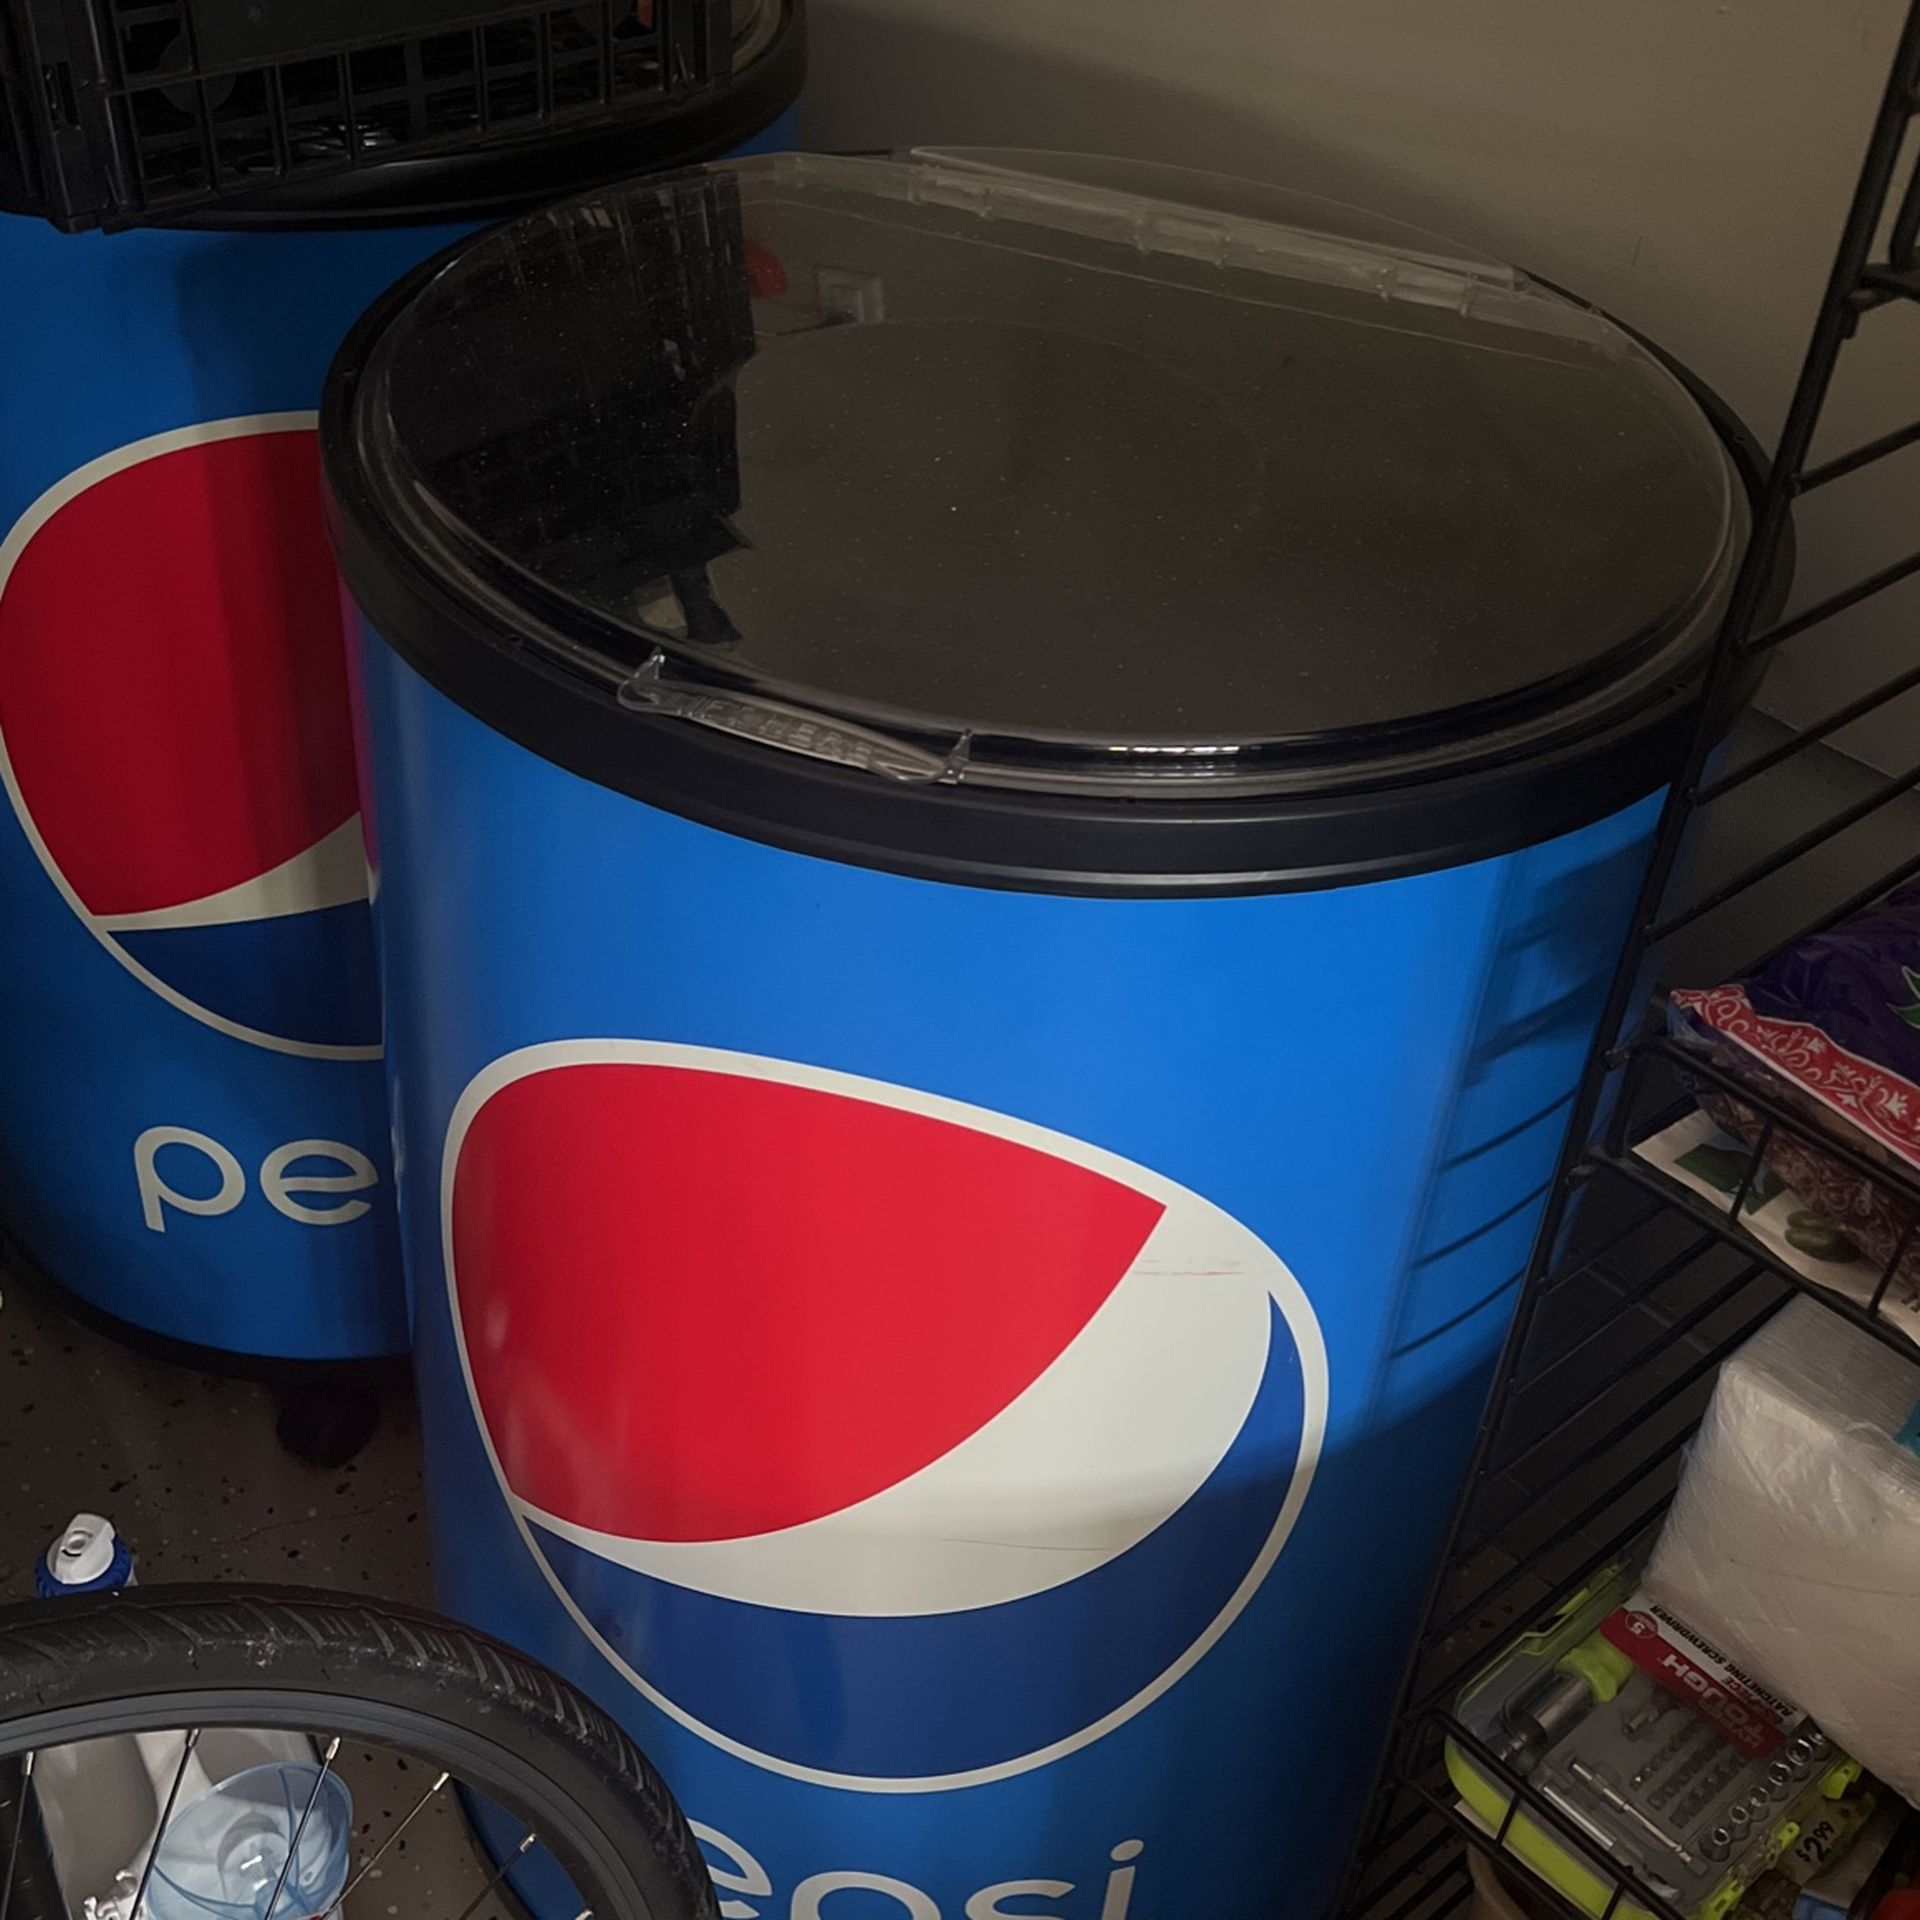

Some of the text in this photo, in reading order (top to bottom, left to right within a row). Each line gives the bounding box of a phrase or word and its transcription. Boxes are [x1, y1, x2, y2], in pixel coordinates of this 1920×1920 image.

[1650, 1605, 1726, 1665] SCREWDRIVER
[1661, 1653, 1768, 1739] TOUGH
[1724, 1663, 1794, 1717] RATCHETING
[1695, 1697, 1762, 1750] HYPER
